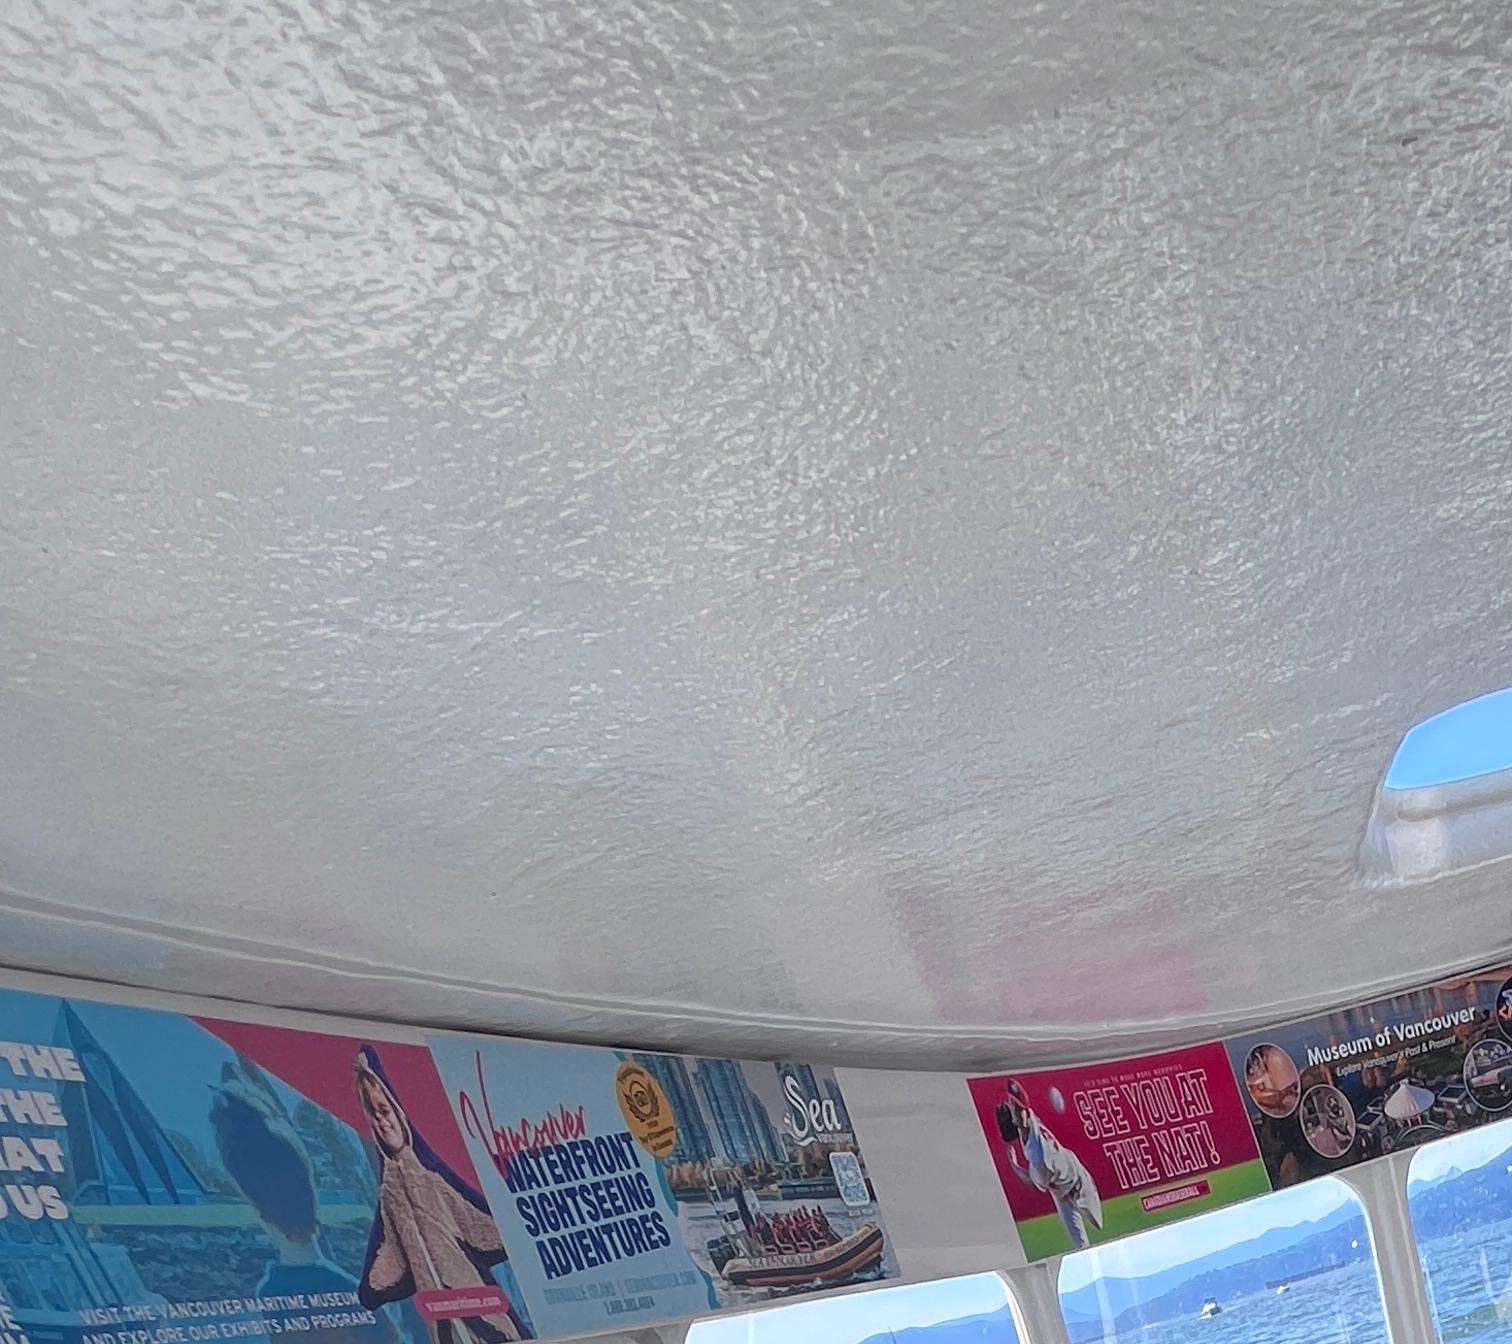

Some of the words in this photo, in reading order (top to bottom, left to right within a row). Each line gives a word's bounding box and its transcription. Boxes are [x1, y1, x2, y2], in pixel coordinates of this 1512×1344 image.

[0, 1040, 87, 1082] THE
[1307, 1035, 1376, 1066] Museum
[1375, 1026, 1392, 1048] of
[1392, 1006, 1477, 1042] Vancouver
[1404, 1045, 1422, 1059] Past
[459, 1051, 586, 1178] Vancouver
[784, 1075, 842, 1140] Sea
[1073, 1087, 1131, 1139] SEE
[1120, 1076, 1183, 1129] YOU
[1175, 1068, 1214, 1118] AT
[505, 1132, 641, 1194] WATERFRONT
[1102, 1135, 1161, 1189] THE
[1151, 1121, 1221, 1178] NAT!
[516, 1171, 656, 1237] SIGHTSEEING
[535, 1211, 672, 1280] ADVENTURES
[80, 1307, 123, 1325] VISIT
[123, 1305, 156, 1321] THE
[158, 1299, 241, 1318] VANCOUVER
[245, 1294, 309, 1313] MARITIME
[308, 1292, 361, 1309] MUSEUM
[189, 1323, 220, 1341] OUR
[222, 1318, 282, 1339] EXHIBITS
[284, 1316, 311, 1332] AND
[311, 1311, 377, 1329] PROGRAMS
